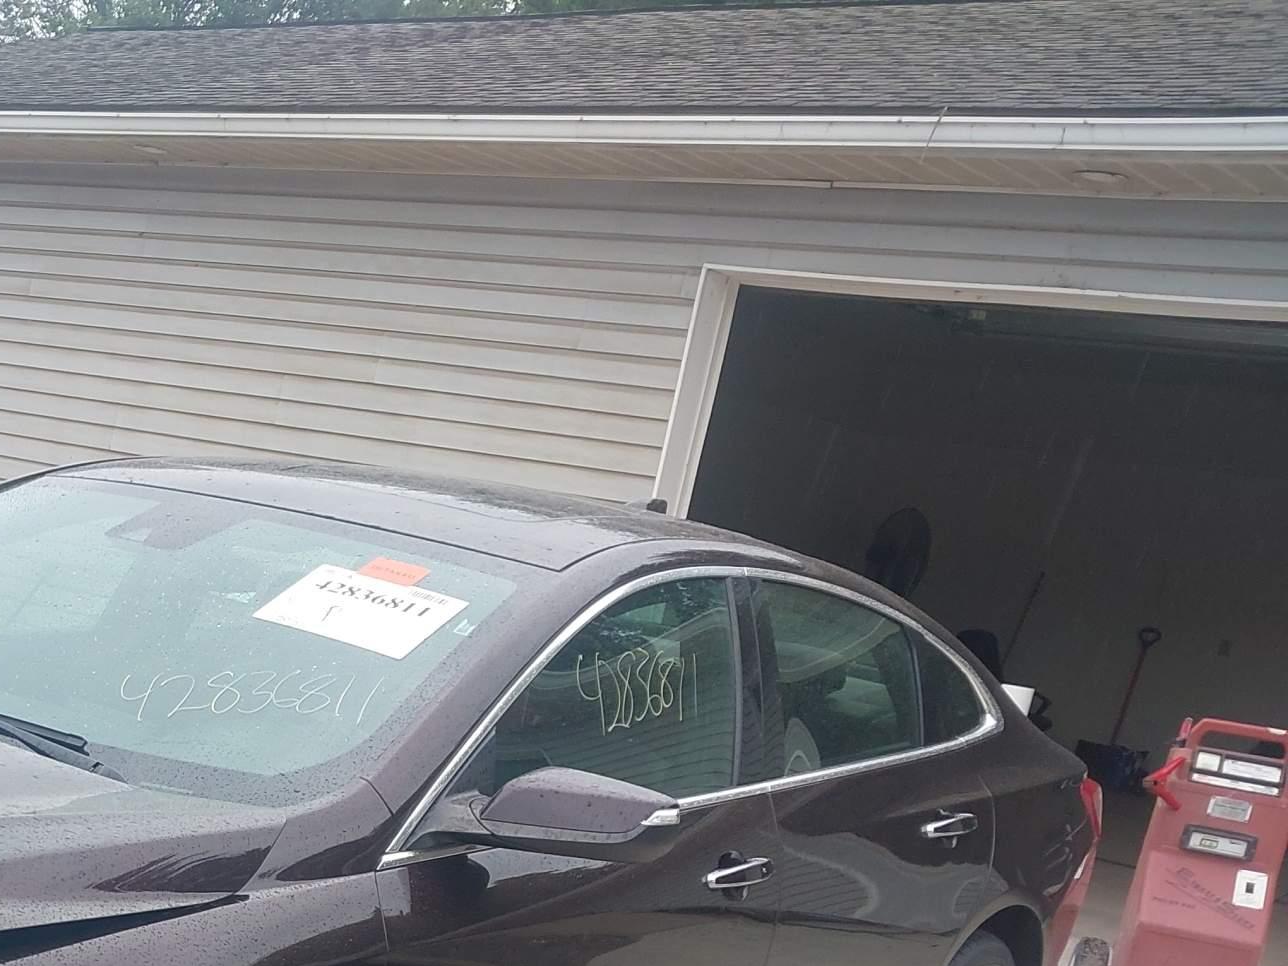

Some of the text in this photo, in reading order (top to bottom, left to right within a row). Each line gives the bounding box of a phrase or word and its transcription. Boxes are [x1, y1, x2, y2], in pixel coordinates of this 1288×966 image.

[315, 580, 431, 617] 42836811
[120, 669, 385, 727] 42836811
[576, 647, 698, 736] 42836811
